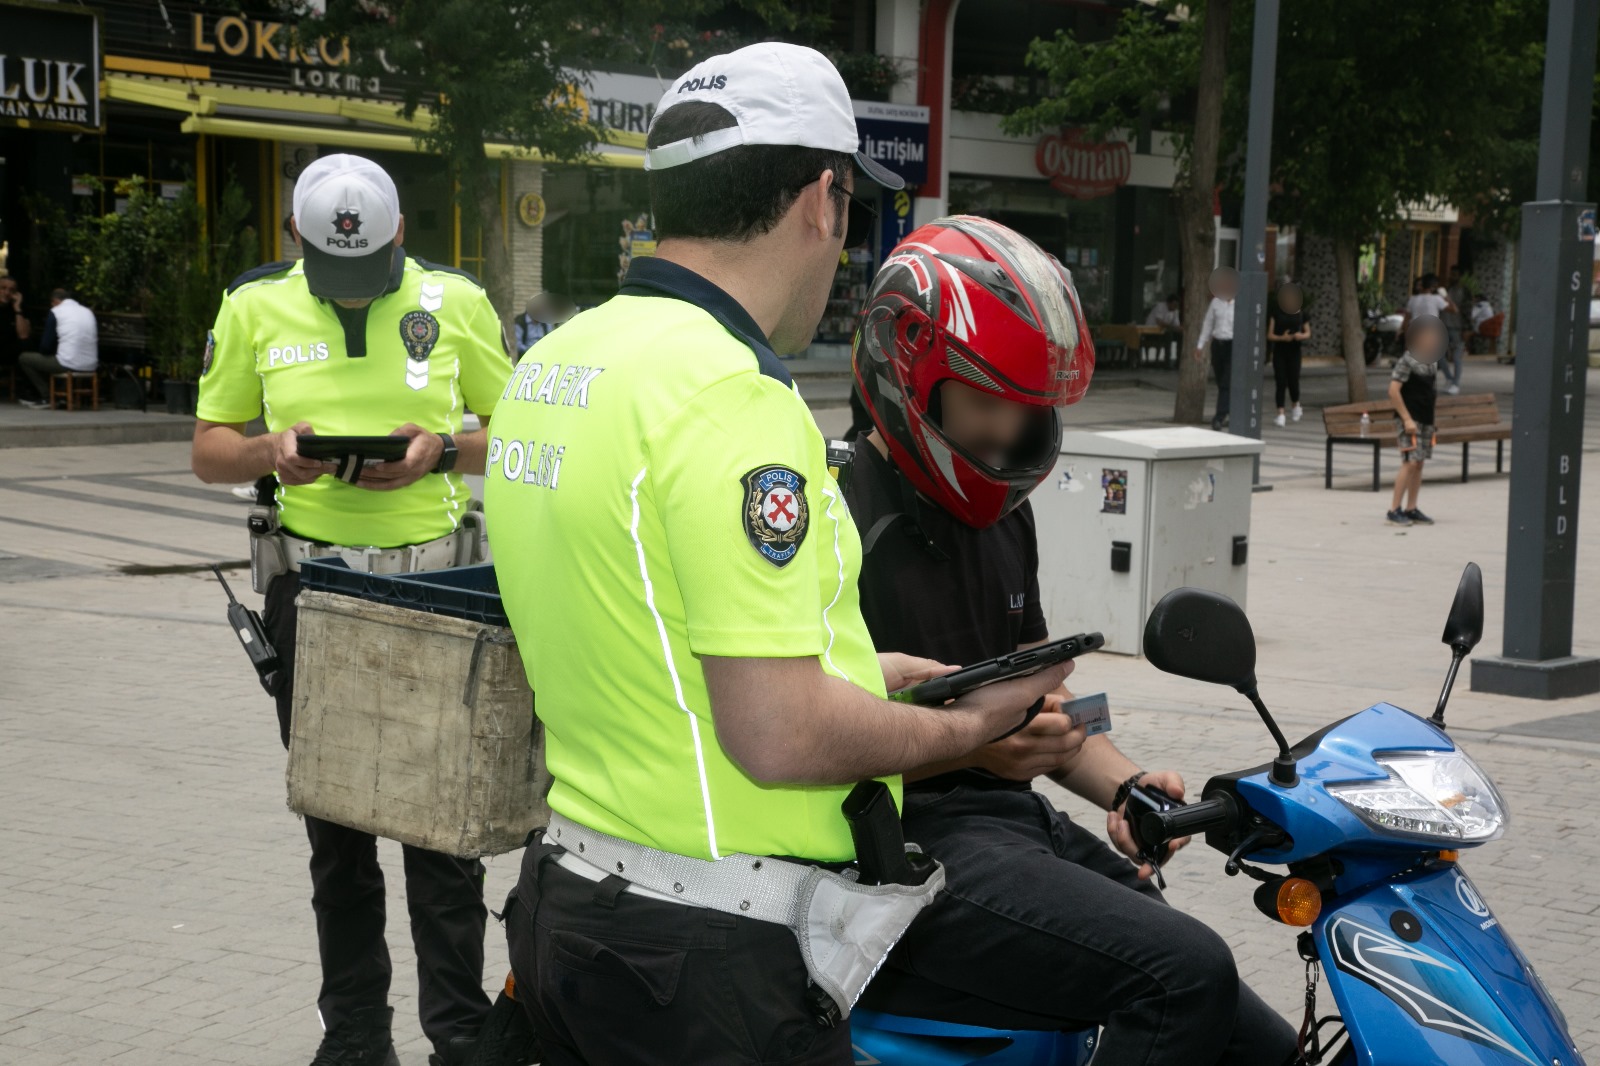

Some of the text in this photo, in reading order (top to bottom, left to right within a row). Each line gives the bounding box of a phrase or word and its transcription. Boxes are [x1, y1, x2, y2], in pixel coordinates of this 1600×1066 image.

[0, 54, 88, 105] LUK
[33, 103, 88, 122] VARIR
[865, 135, 924, 165] İLETİŞİM
